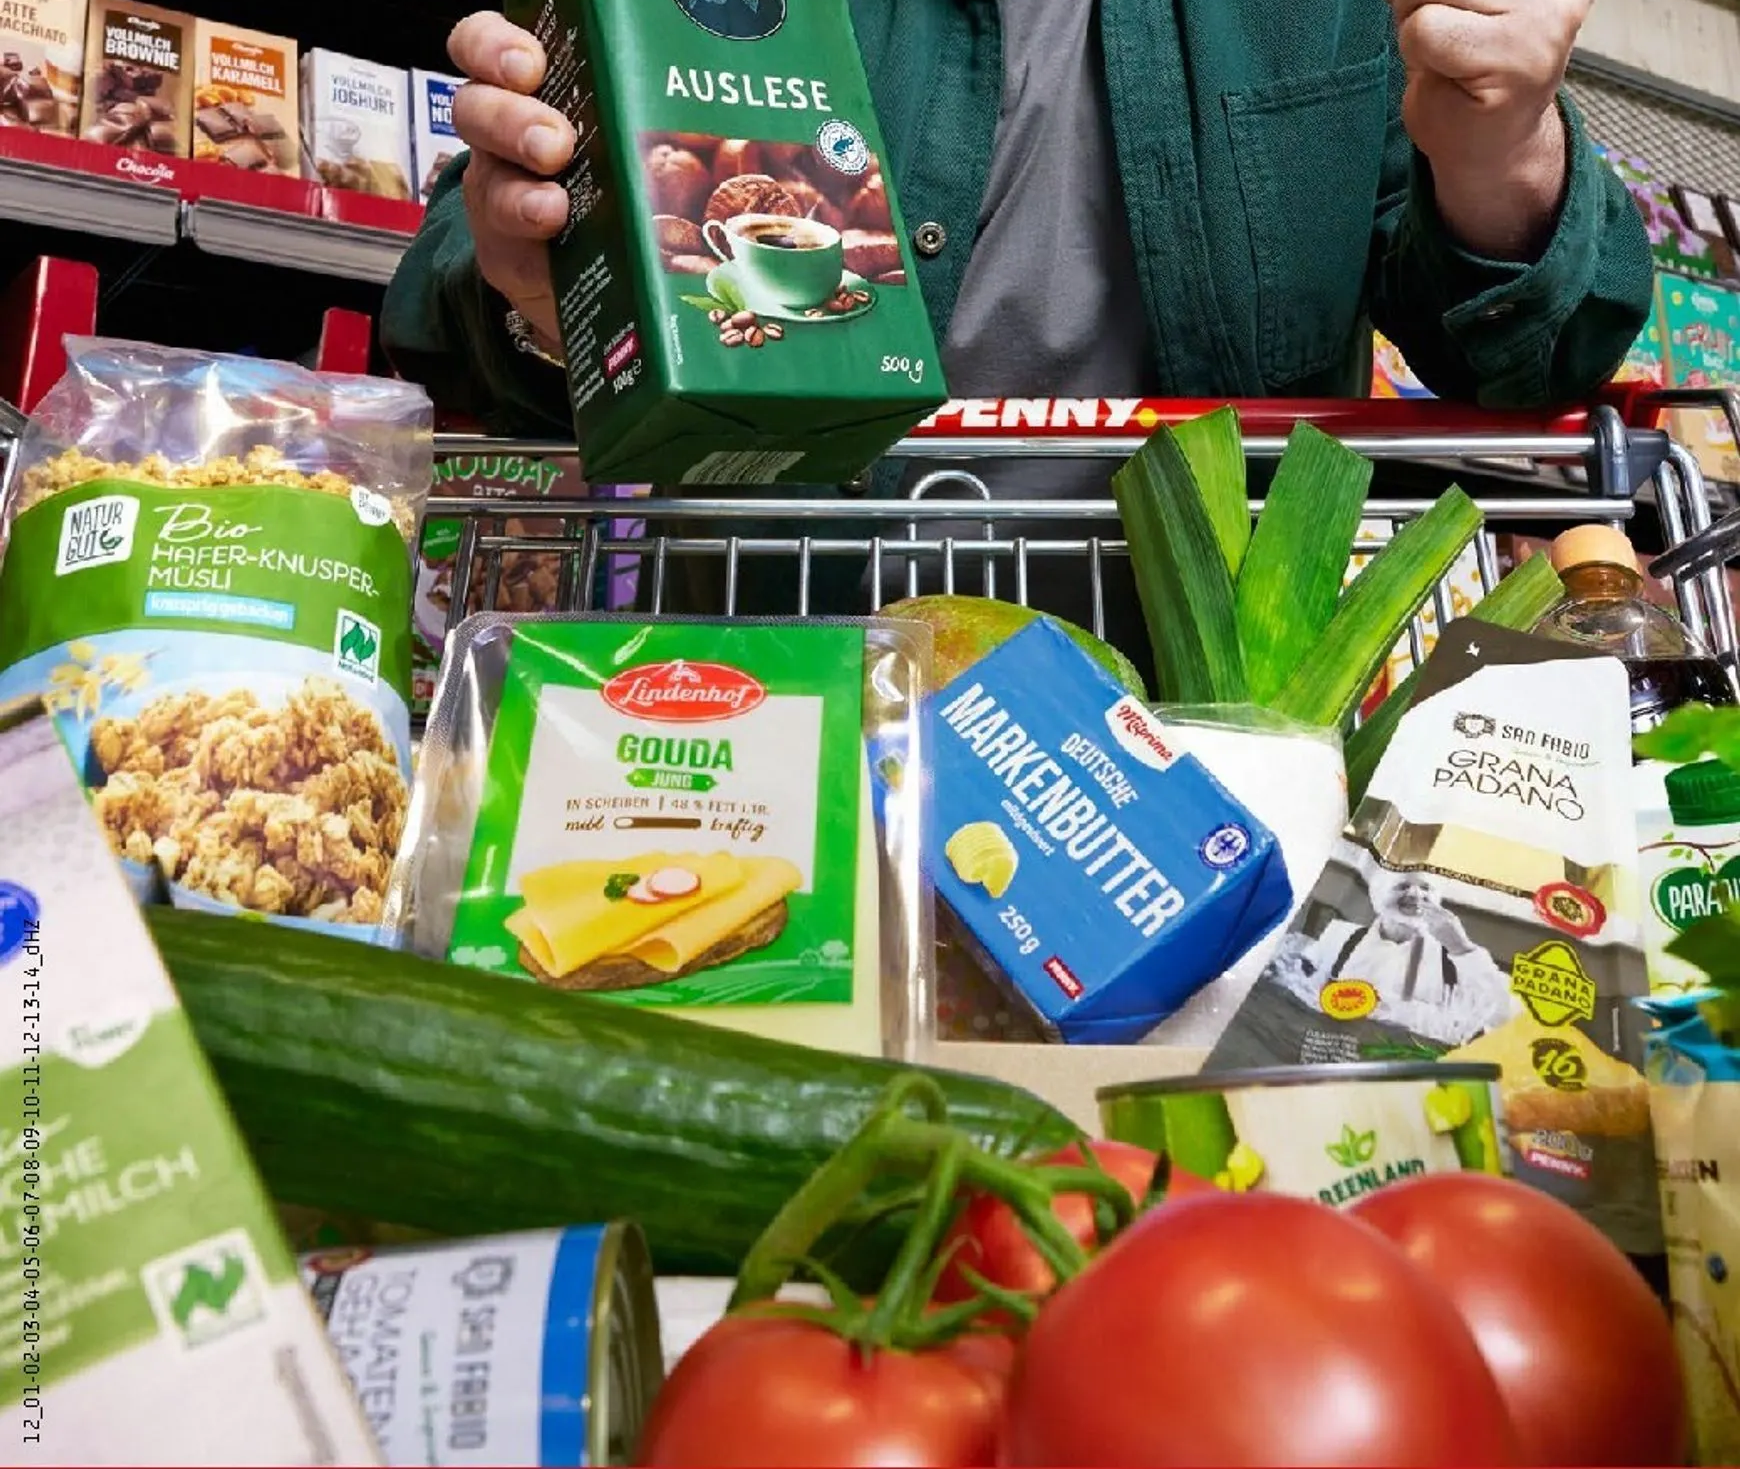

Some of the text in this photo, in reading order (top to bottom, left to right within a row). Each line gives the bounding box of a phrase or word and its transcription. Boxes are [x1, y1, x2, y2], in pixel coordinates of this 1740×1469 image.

[0, 0, 37, 21] ATTE
[104, 38, 180, 70] BROWNIE
[105, 25, 171, 52] VOLLMILCH
[211, 65, 284, 94] KARAMELL
[666, 65, 833, 112] AUSLESE
[331, 85, 394, 116] JOGHURT
[431, 455, 565, 496] NOUGAT
[70, 500, 124, 530] NATUR
[153, 503, 263, 543] Bio
[64, 529, 100, 561] GUT
[147, 564, 232, 591] MÜSLI
[618, 676, 752, 709] Lindenhof
[615, 732, 735, 772] GOUDA
[1501, 724, 1535, 746] SAN
[1541, 732, 1591, 760] FABIO
[651, 770, 693, 789] JUNG
[1060, 732, 1138, 809] DEUTSCHE
[1448, 749, 1578, 799] GRANA
[585, 795, 650, 810] SCHEIBEN
[939, 682, 1185, 938] MARKENBUTTER
[1432, 767, 1585, 821] PADANO
[1513, 976, 1592, 1009] PADANO
[1515, 962, 1592, 1000] GRANA
[1317, 1158, 1426, 1206] REENLAND
